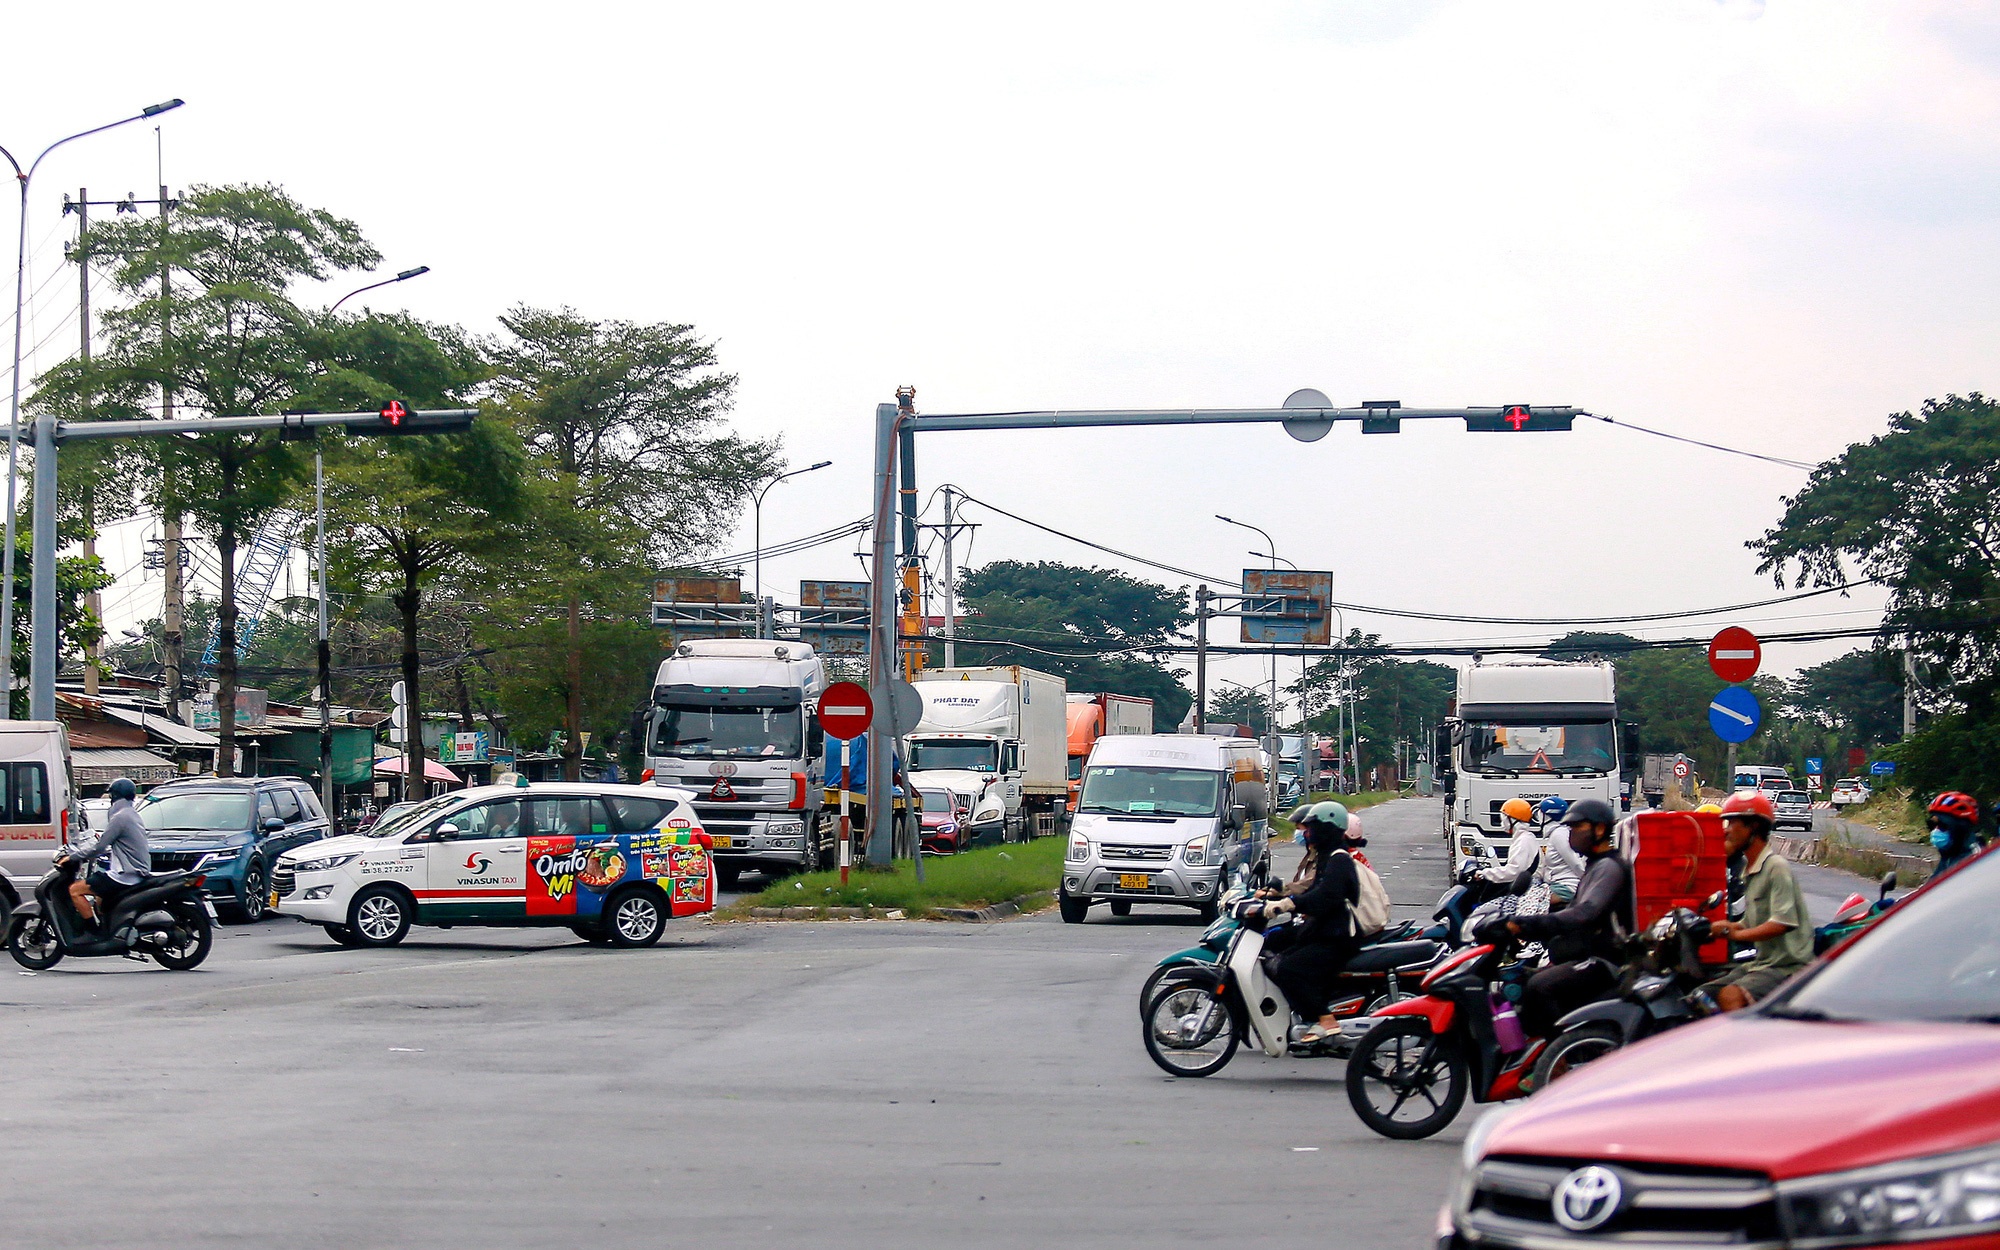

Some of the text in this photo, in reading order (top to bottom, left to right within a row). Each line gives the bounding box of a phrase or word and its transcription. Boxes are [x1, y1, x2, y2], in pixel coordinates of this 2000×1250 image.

[717, 765, 732, 774] LH
[457, 876, 517, 885] VINASUN TAXI
